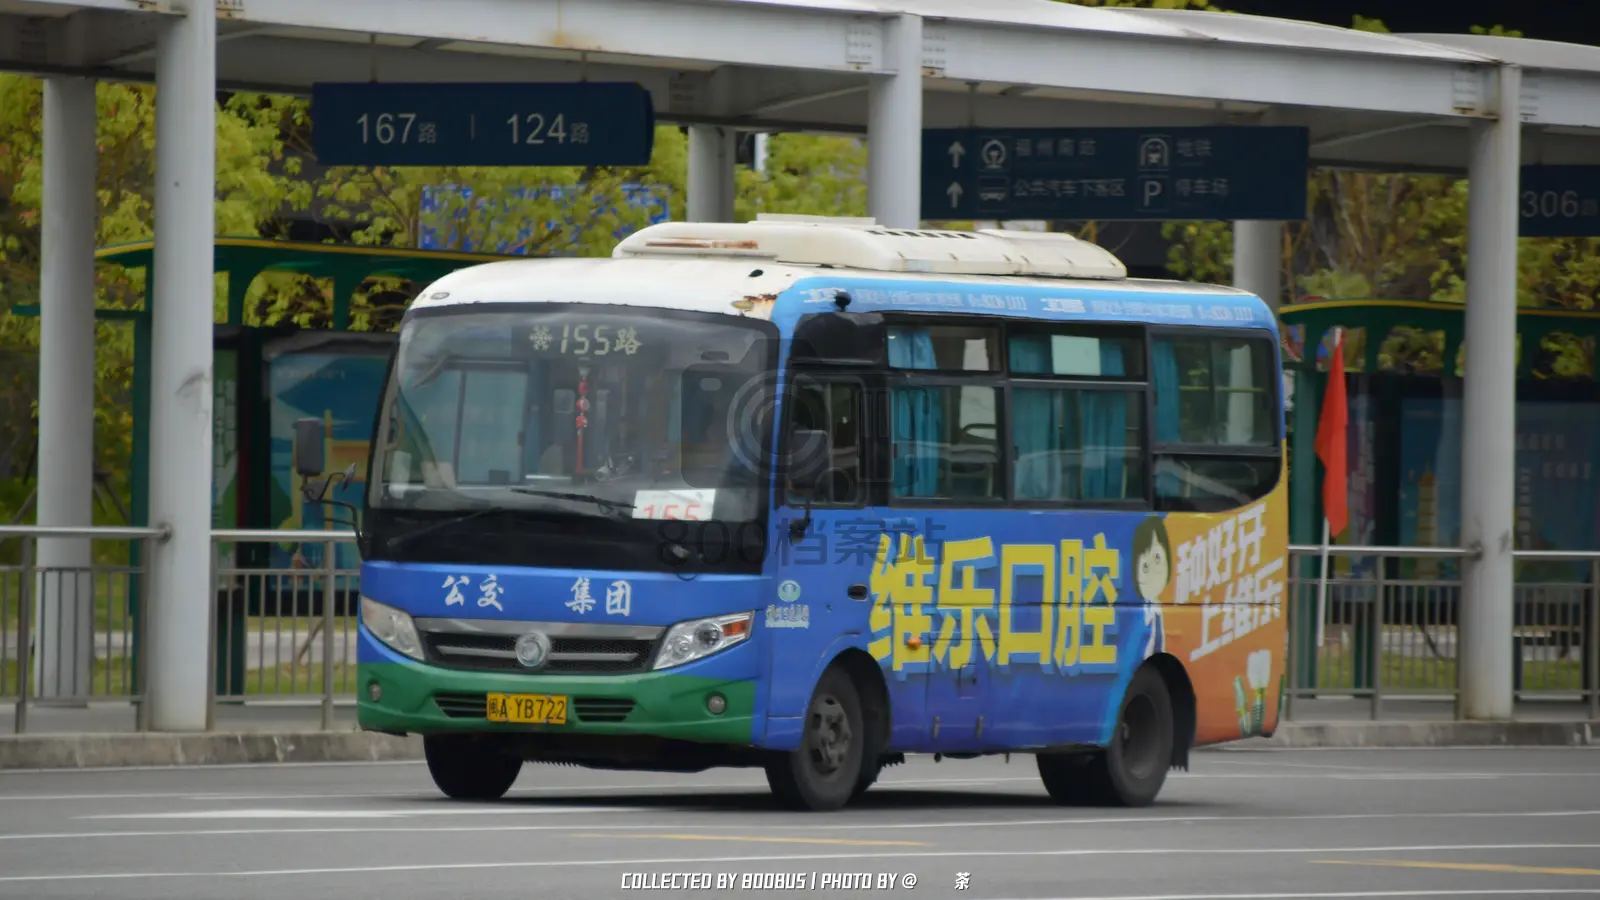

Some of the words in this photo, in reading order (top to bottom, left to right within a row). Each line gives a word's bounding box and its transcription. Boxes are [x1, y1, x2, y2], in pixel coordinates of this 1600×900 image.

[559, 323, 643, 357] 155路
[441, 573, 504, 612] 公交
[564, 575, 632, 617] 集团
[867, 531, 1119, 672] 维乐口腔
[1175, 502, 1267, 605] 种好牙
[1189, 555, 1285, 663] 上维乐
